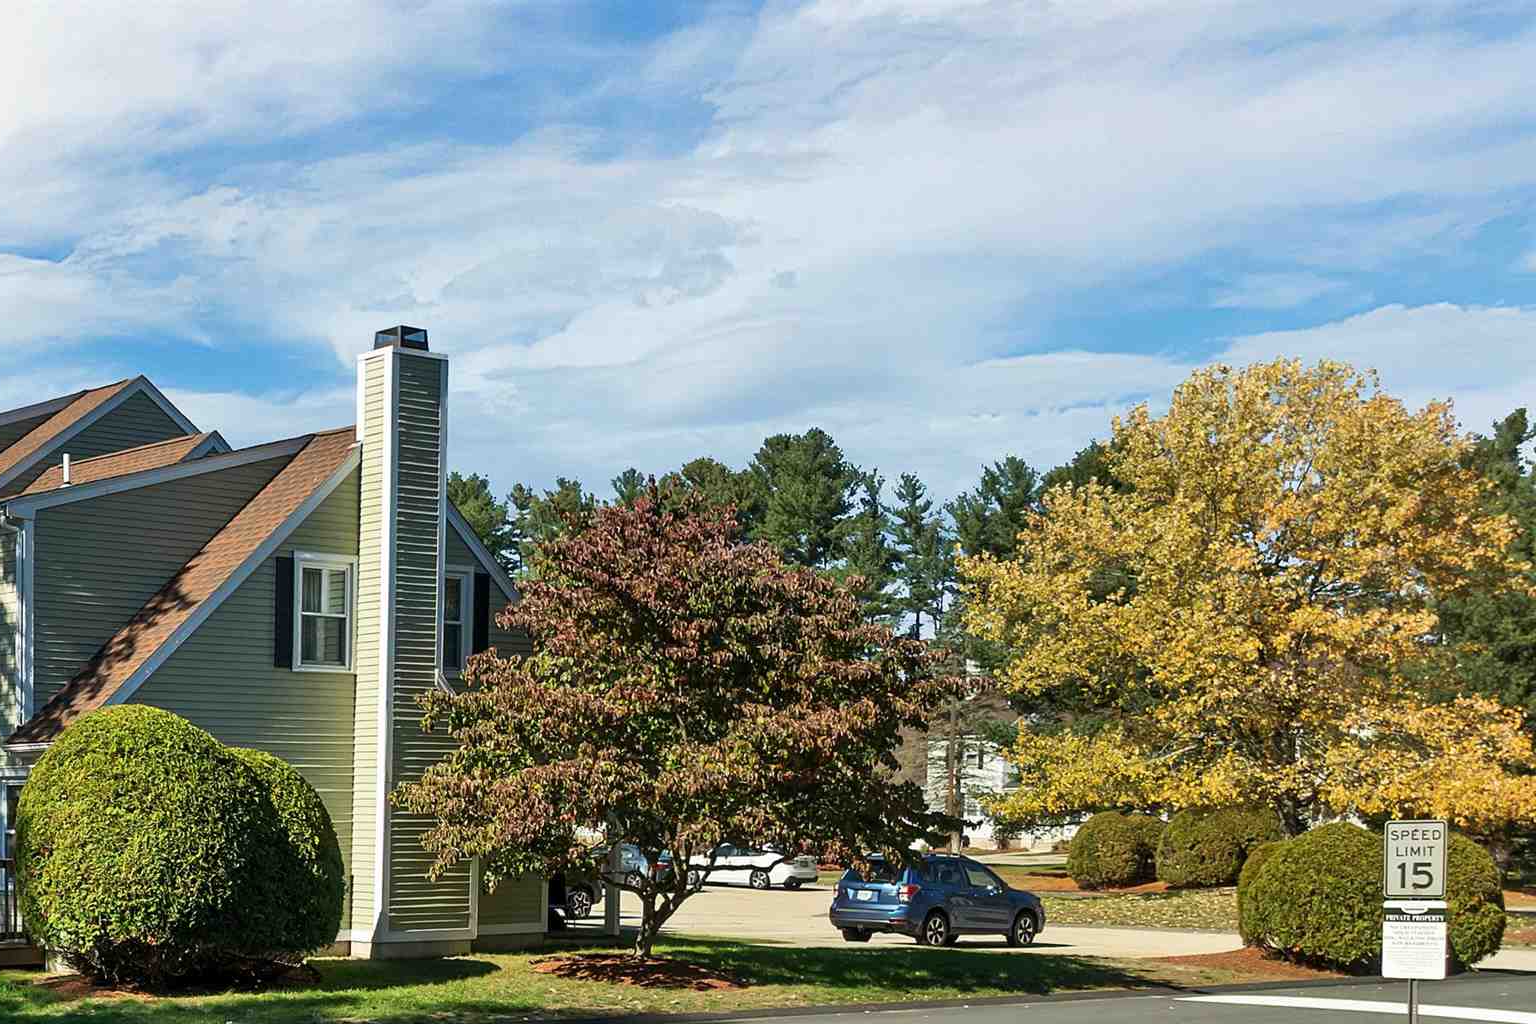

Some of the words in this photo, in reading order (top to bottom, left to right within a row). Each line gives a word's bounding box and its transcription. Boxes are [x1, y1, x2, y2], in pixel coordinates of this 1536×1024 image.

[1391, 829, 1441, 840] SPEED
[1396, 846, 1435, 857] LIMIT
[1397, 862, 1433, 889] 15
